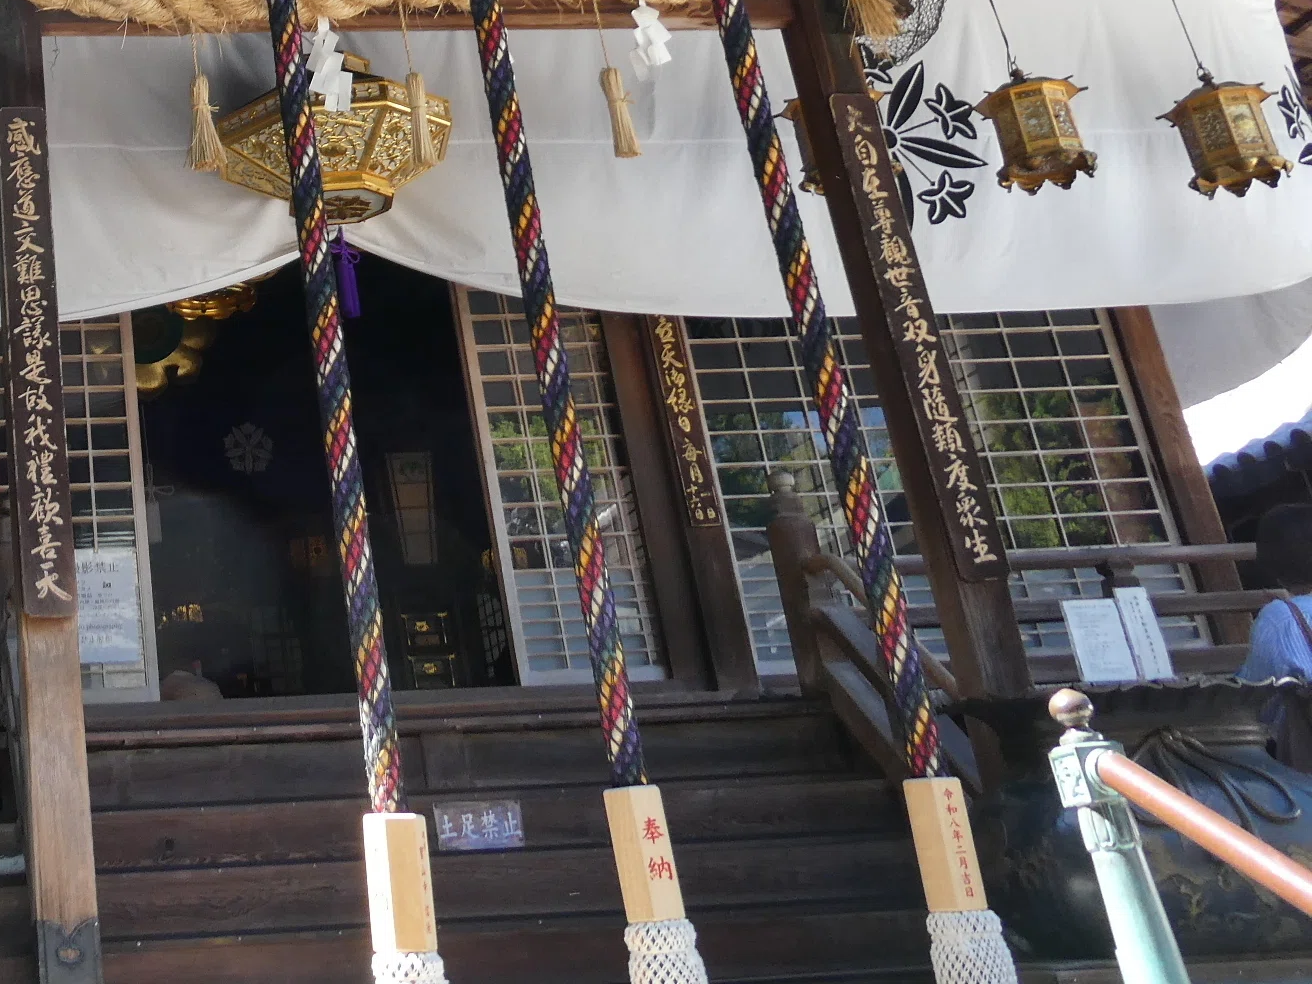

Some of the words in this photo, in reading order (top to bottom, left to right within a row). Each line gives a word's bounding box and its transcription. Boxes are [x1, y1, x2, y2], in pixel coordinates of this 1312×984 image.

[440, 809, 523, 840] 土足禁止
[641, 816, 674, 881] 奉納
[943, 787, 975, 898] 令和八年二月吉日
